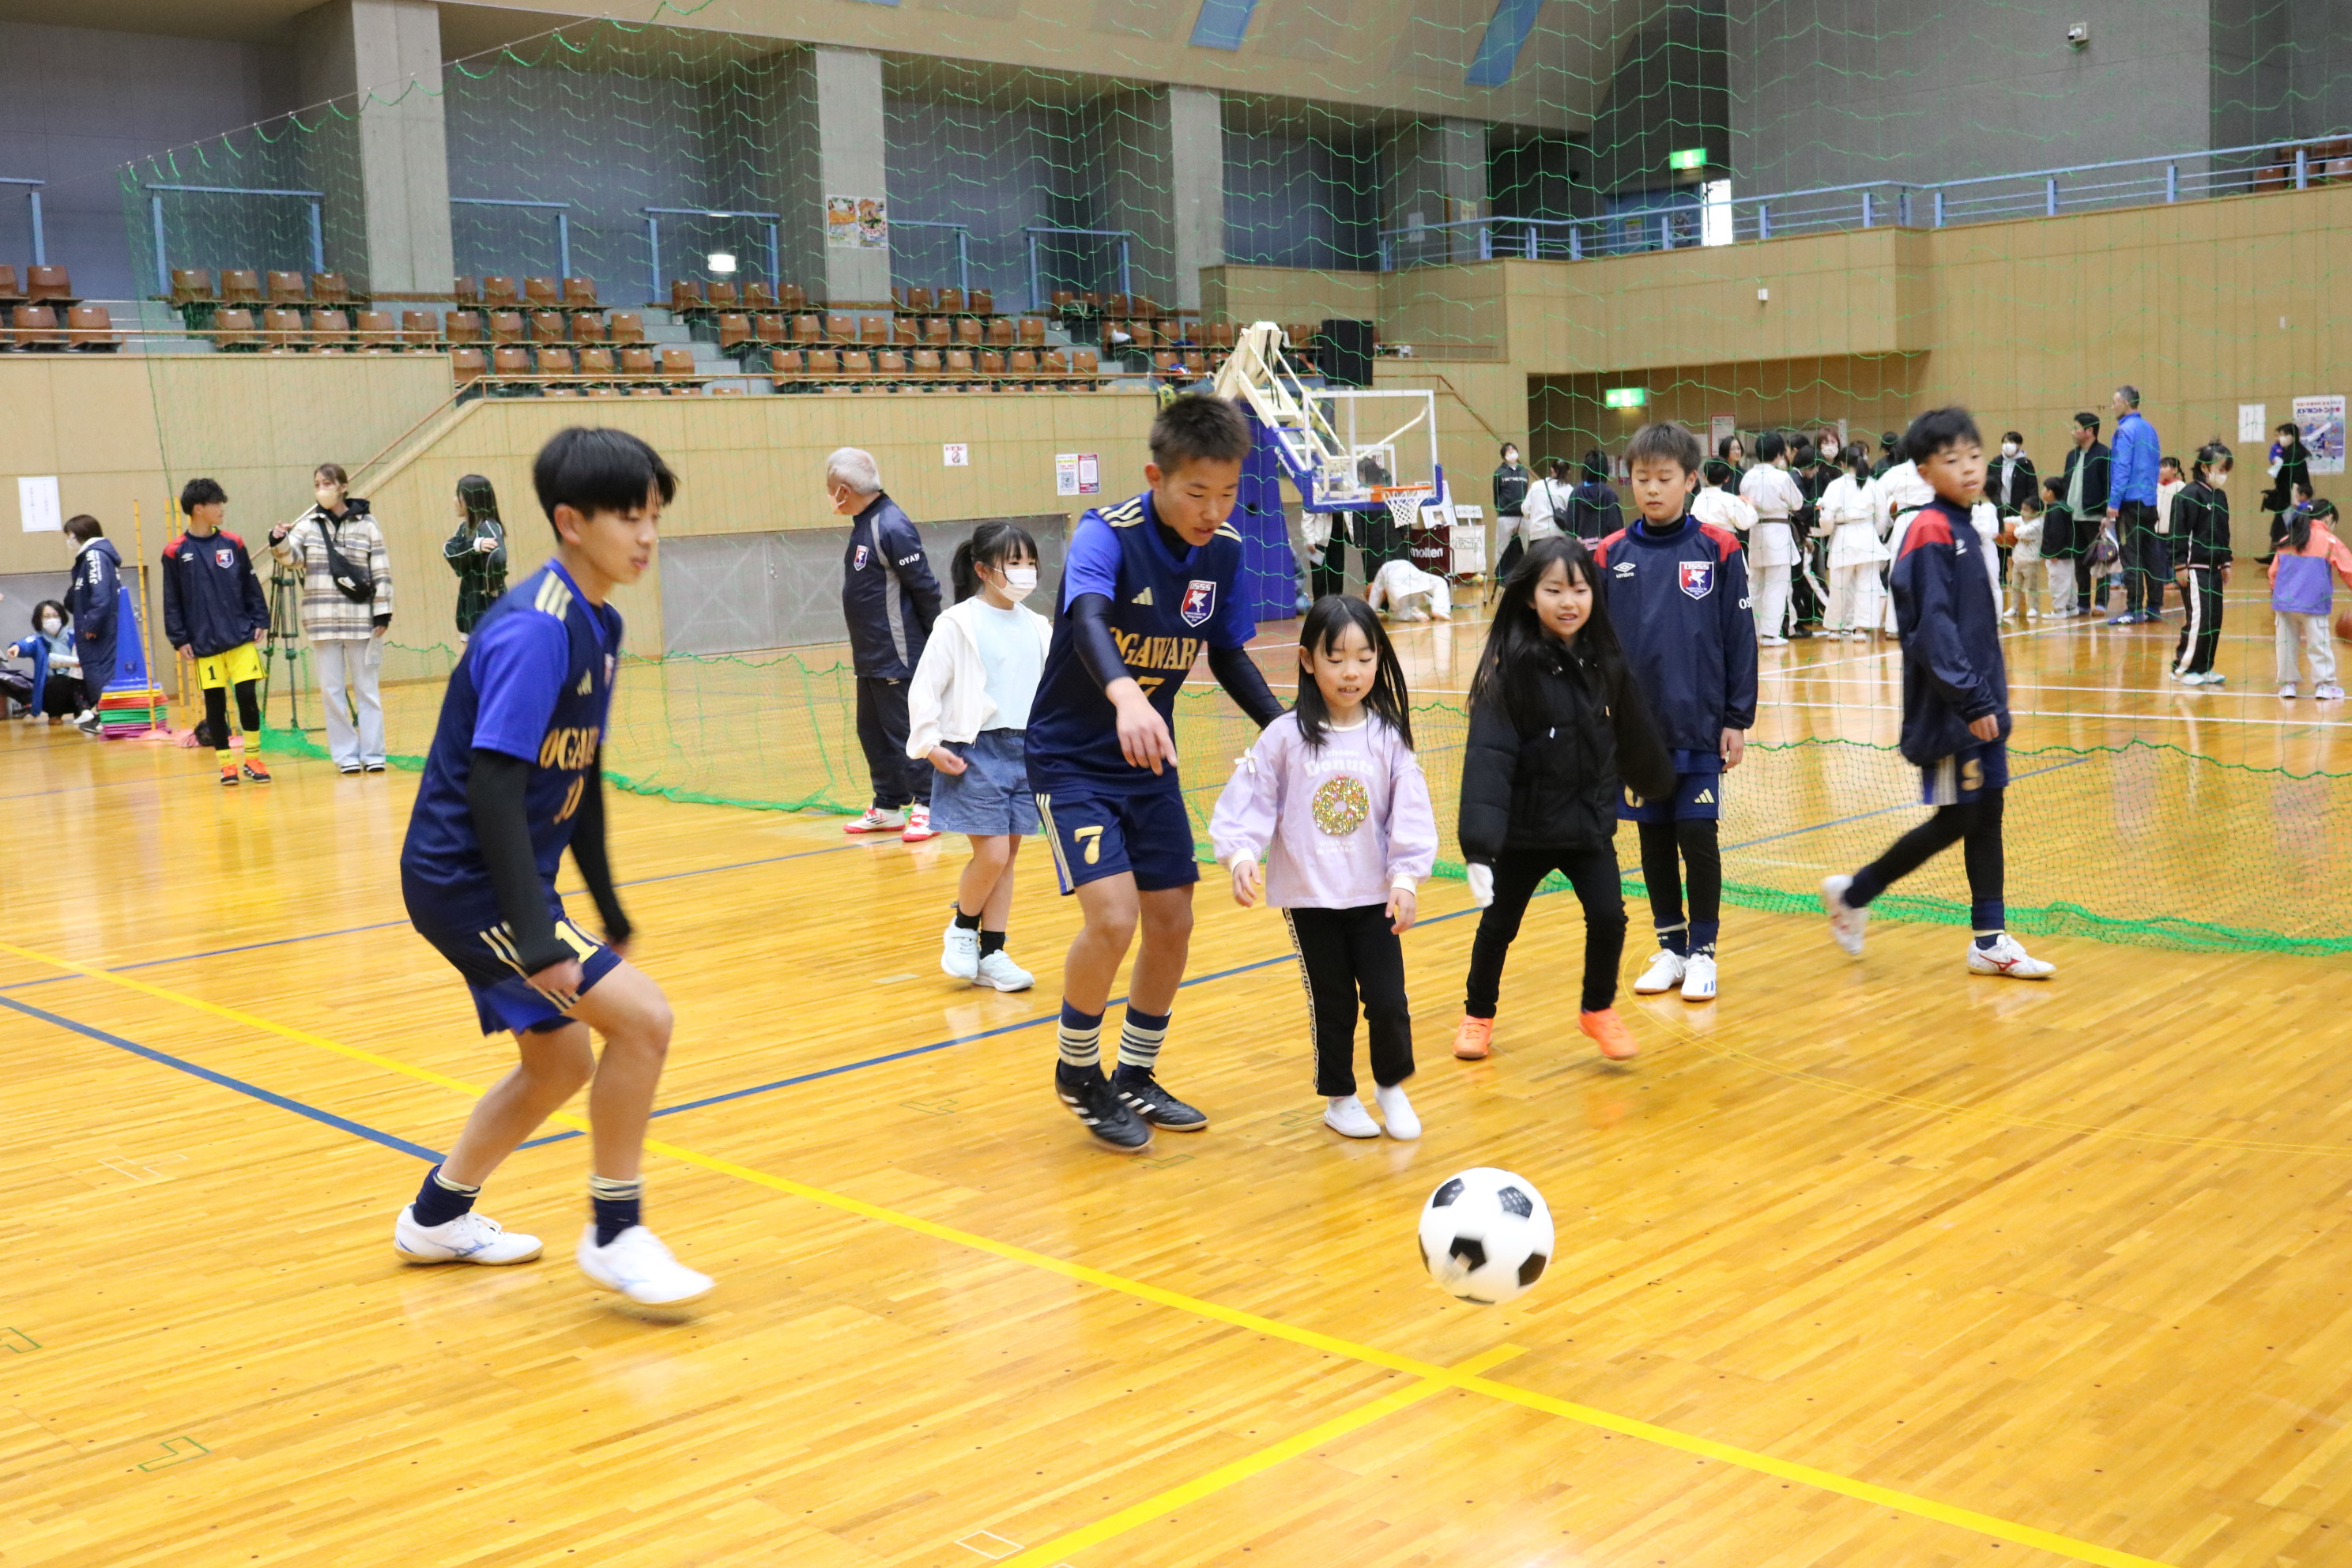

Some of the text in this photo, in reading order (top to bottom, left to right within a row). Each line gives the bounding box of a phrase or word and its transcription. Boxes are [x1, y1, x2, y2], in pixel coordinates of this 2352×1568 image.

[1410, 547, 1444, 558] molten
[207, 665, 217, 680] 1
[1325, 748, 1360, 758] choose
[1303, 759, 1375, 778] Donuts
[1074, 825, 1105, 865] 7
